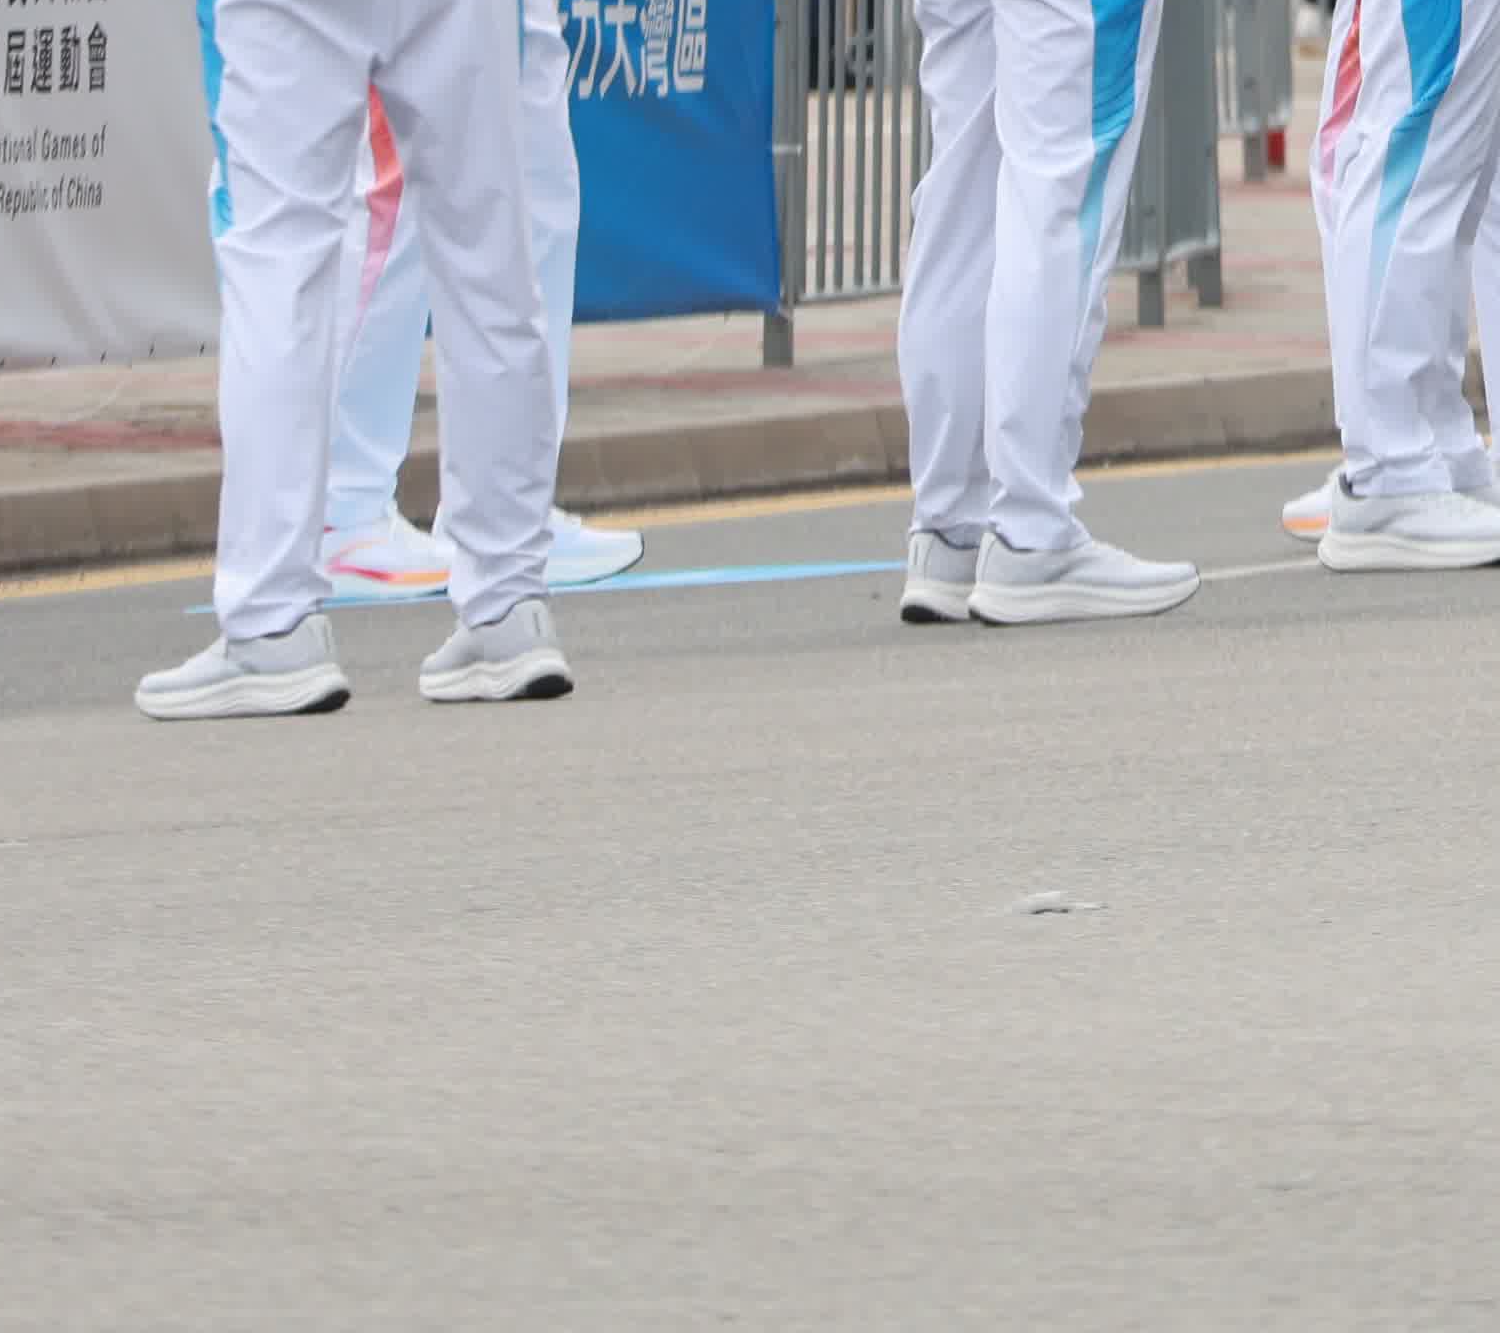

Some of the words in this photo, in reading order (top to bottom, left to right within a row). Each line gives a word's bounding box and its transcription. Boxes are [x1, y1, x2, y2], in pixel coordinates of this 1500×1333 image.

[41, 129, 87, 162] Games
[91, 121, 108, 158] of
[51, 173, 66, 210] of
[66, 173, 103, 209] China
